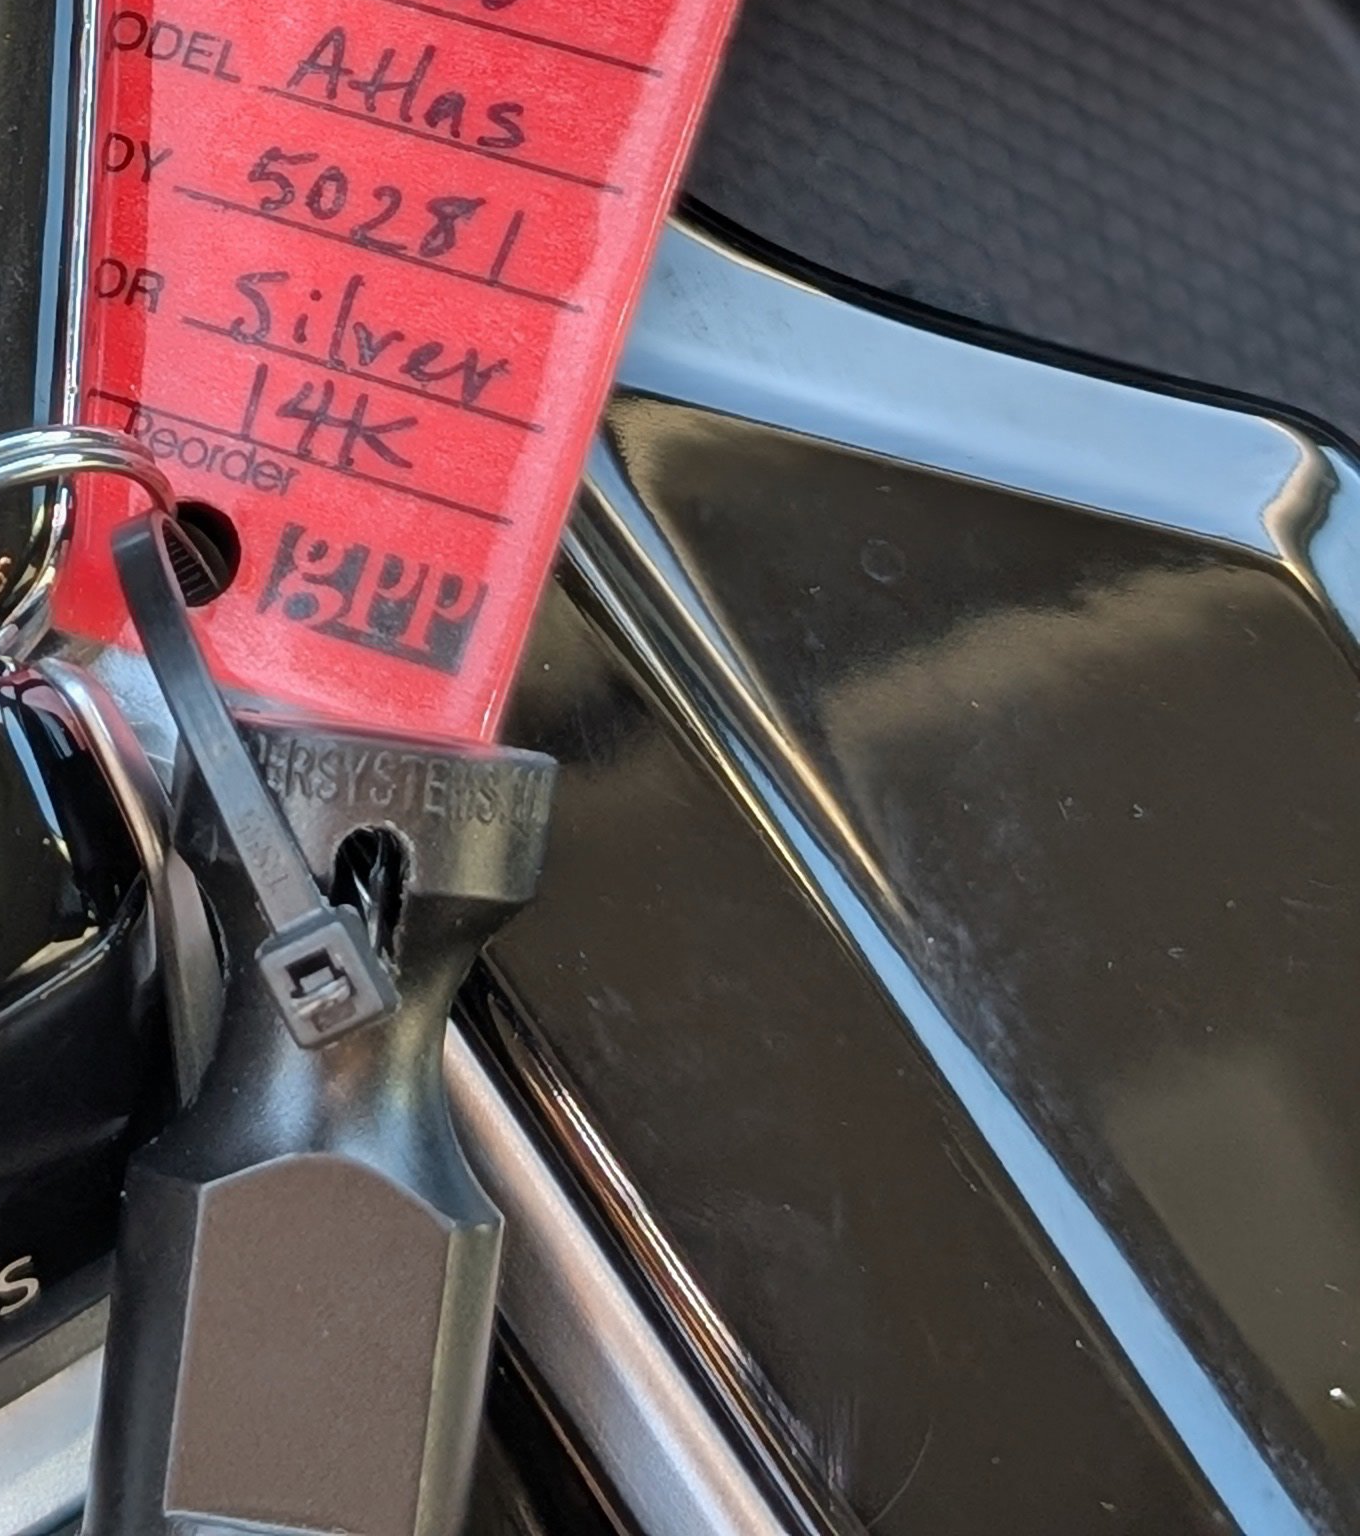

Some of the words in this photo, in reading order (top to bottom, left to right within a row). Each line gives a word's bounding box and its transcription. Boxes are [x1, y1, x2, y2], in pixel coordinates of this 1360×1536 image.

[104, 10, 242, 84] ODEL
[285, 26, 527, 150] Atlas
[102, 131, 174, 184] DY
[246, 144, 525, 286] 50281
[226, 270, 511, 409] Silver
[124, 402, 301, 497] Reorder
[239, 362, 419, 471] 14K
